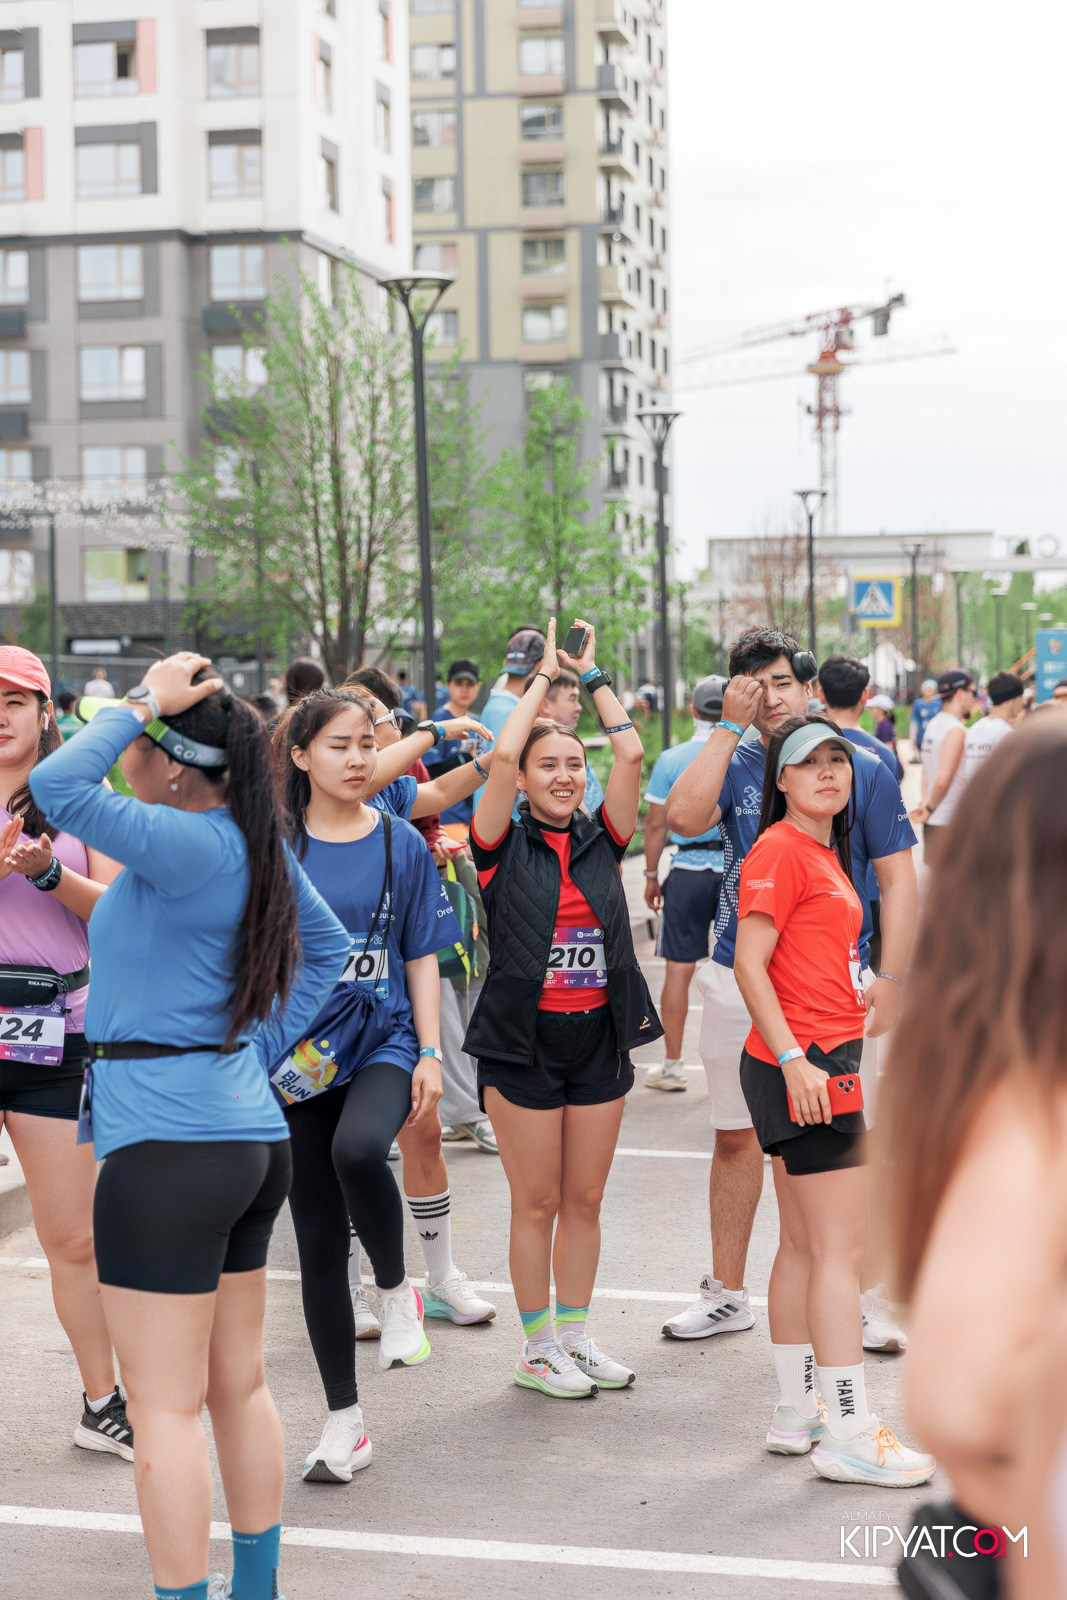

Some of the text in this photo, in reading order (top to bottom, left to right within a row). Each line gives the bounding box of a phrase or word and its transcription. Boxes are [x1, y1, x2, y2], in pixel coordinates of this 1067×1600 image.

[547, 947, 595, 968] 210
[0, 1017, 45, 1042] 24
[281, 1070, 301, 1084] BI
[277, 1080, 311, 1100] RUN
[805, 1355, 814, 1394] HAWK
[836, 1379, 855, 1418] HAWK
